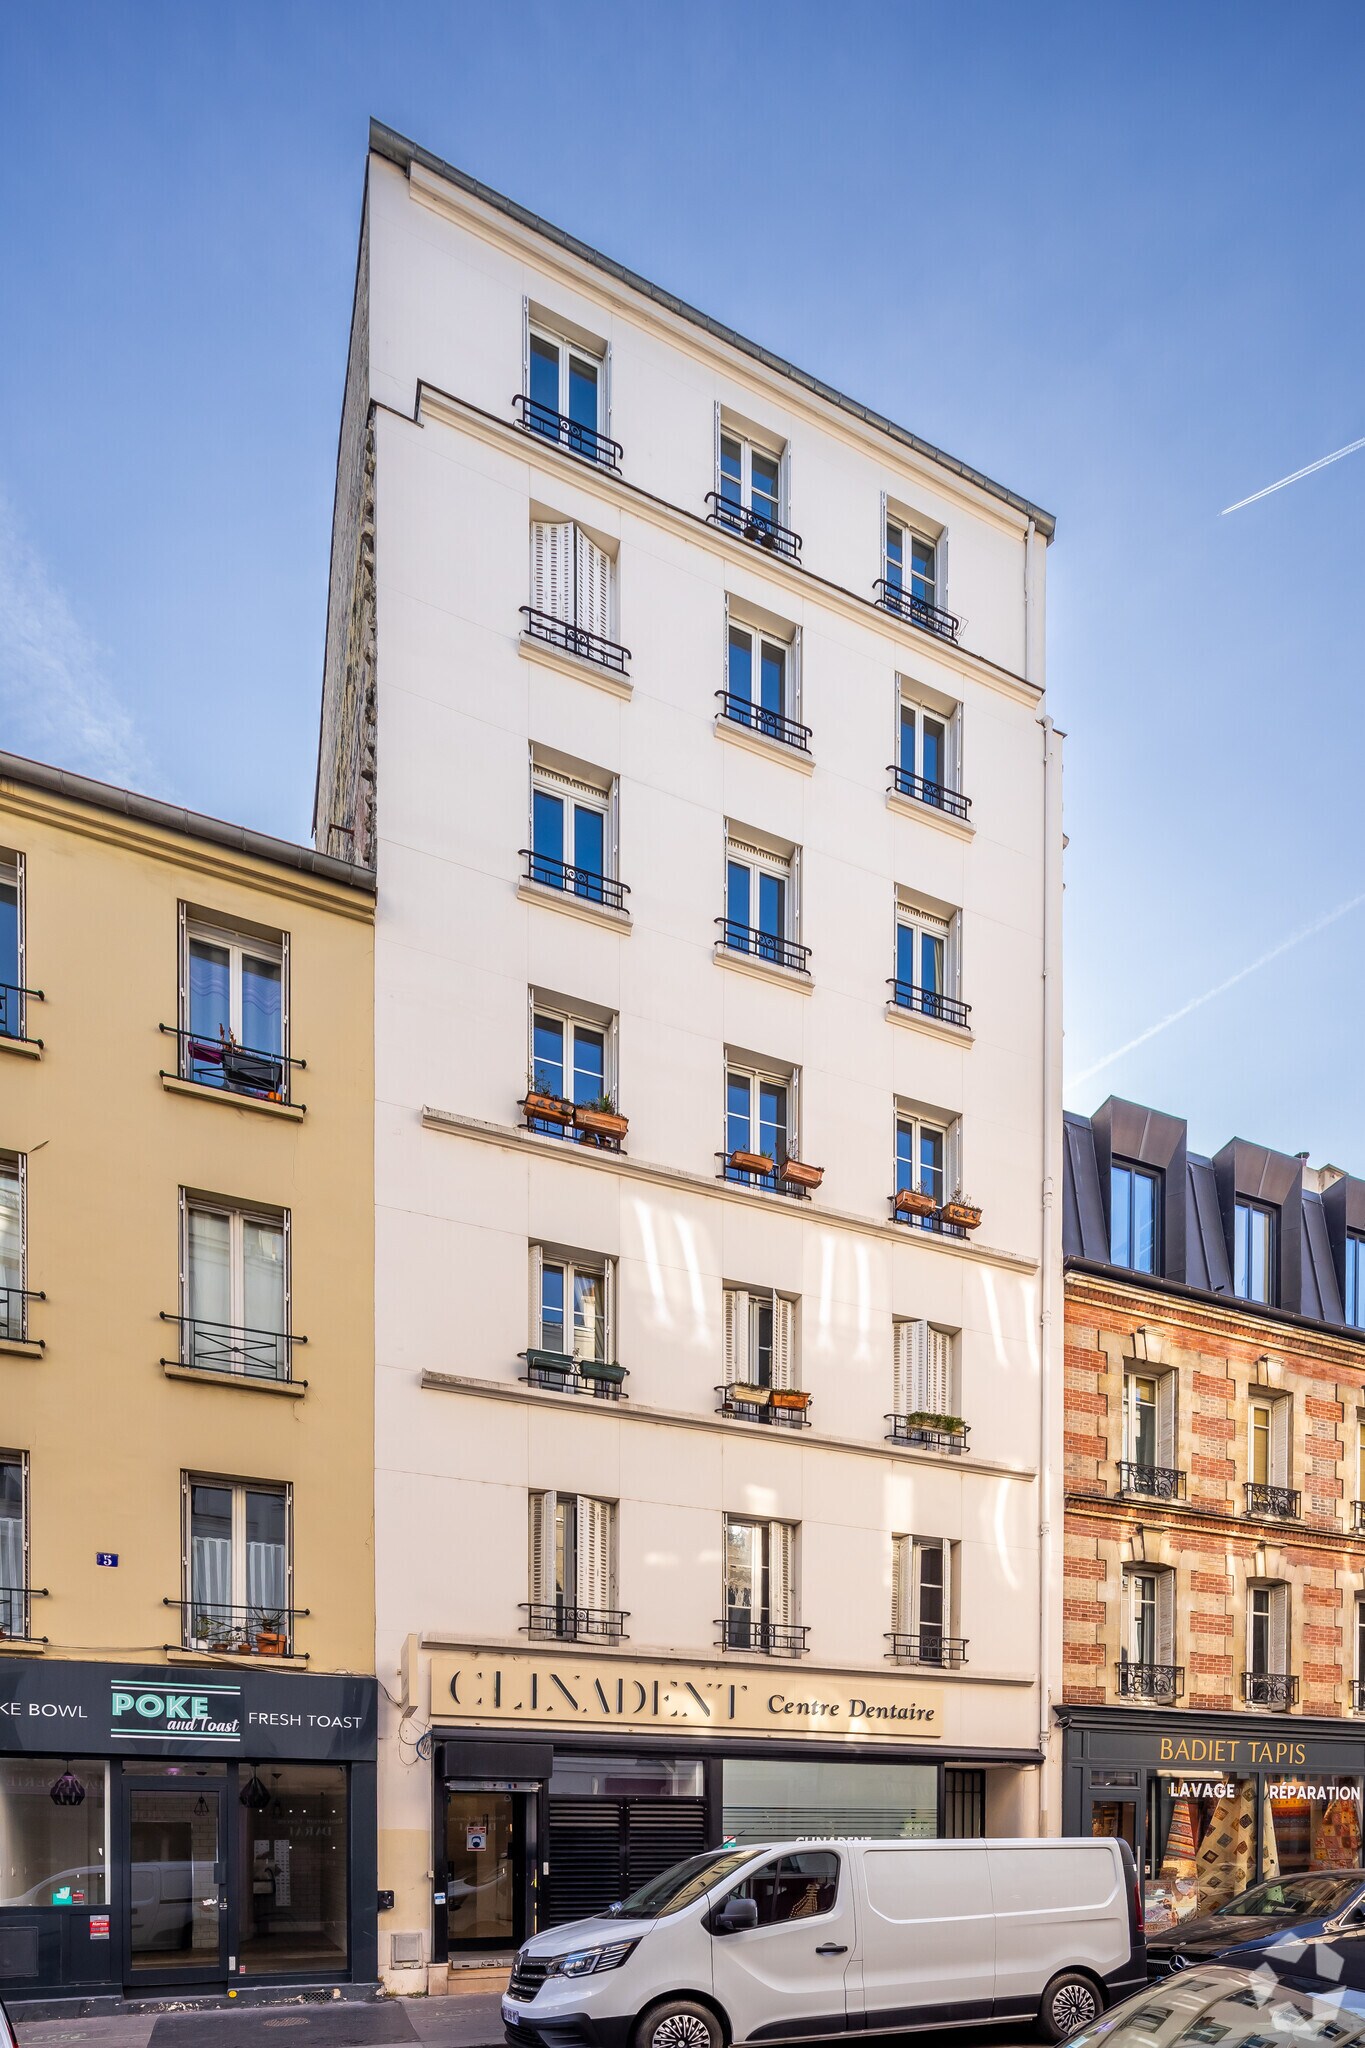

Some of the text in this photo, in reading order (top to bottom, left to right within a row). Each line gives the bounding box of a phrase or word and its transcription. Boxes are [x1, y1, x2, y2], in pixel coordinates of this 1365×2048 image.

[103, 1554, 113, 1566] 5
[450, 1670, 748, 1720] CLINADENT
[28, 1703, 88, 1718] BOWL
[112, 1692, 208, 1719] POKE
[767, 1694, 935, 1721] Centre Dentaire
[167, 1716, 240, 1733] and Toast
[248, 1712, 363, 1729] FRESH TOAST
[1160, 1737, 1306, 1765] BADIET TAPIS
[1170, 1782, 1236, 1799] LAVAGE
[1269, 1782, 1361, 1801] RÉPARATION
